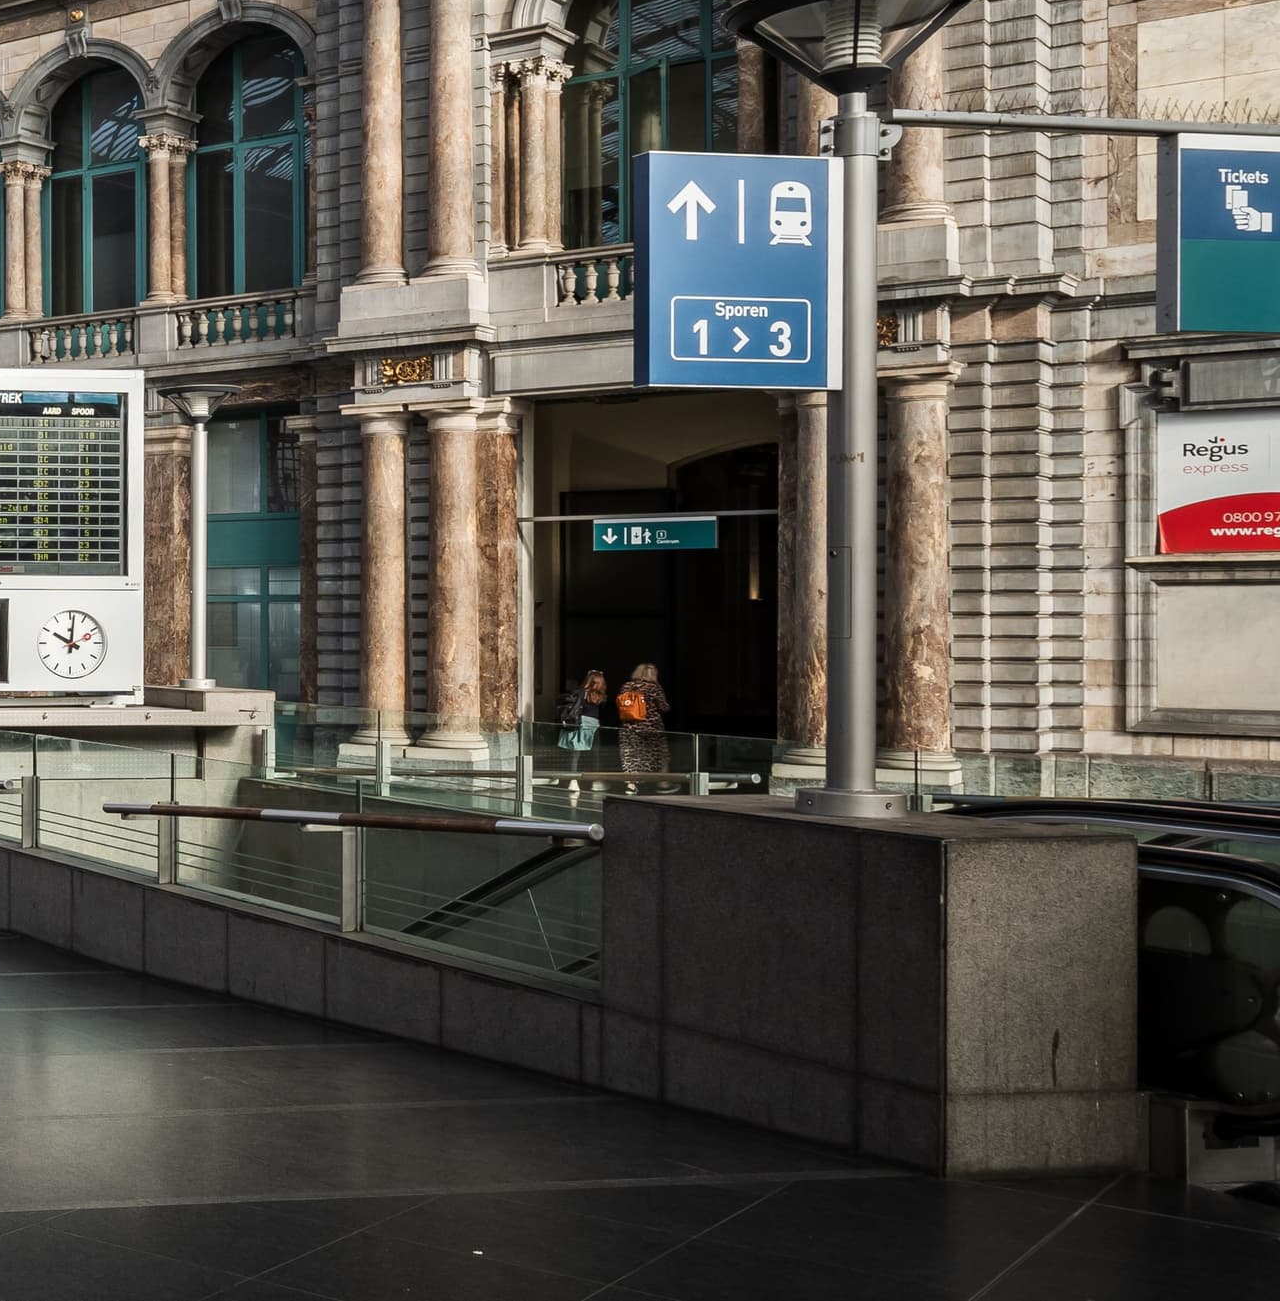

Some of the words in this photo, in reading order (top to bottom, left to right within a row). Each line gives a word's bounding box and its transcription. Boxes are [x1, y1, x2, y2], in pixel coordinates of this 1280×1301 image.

[1218, 168, 1269, 184] Tickets
[715, 301, 768, 320] Sporen
[693, 319, 708, 355] 1
[769, 321, 791, 357] 3
[42, 407, 62, 415] AARD
[71, 407, 95, 416] SPOOR
[1183, 443, 1249, 462] Regus
[1183, 463, 1249, 476] express
[1223, 512, 1262, 524] 0800
